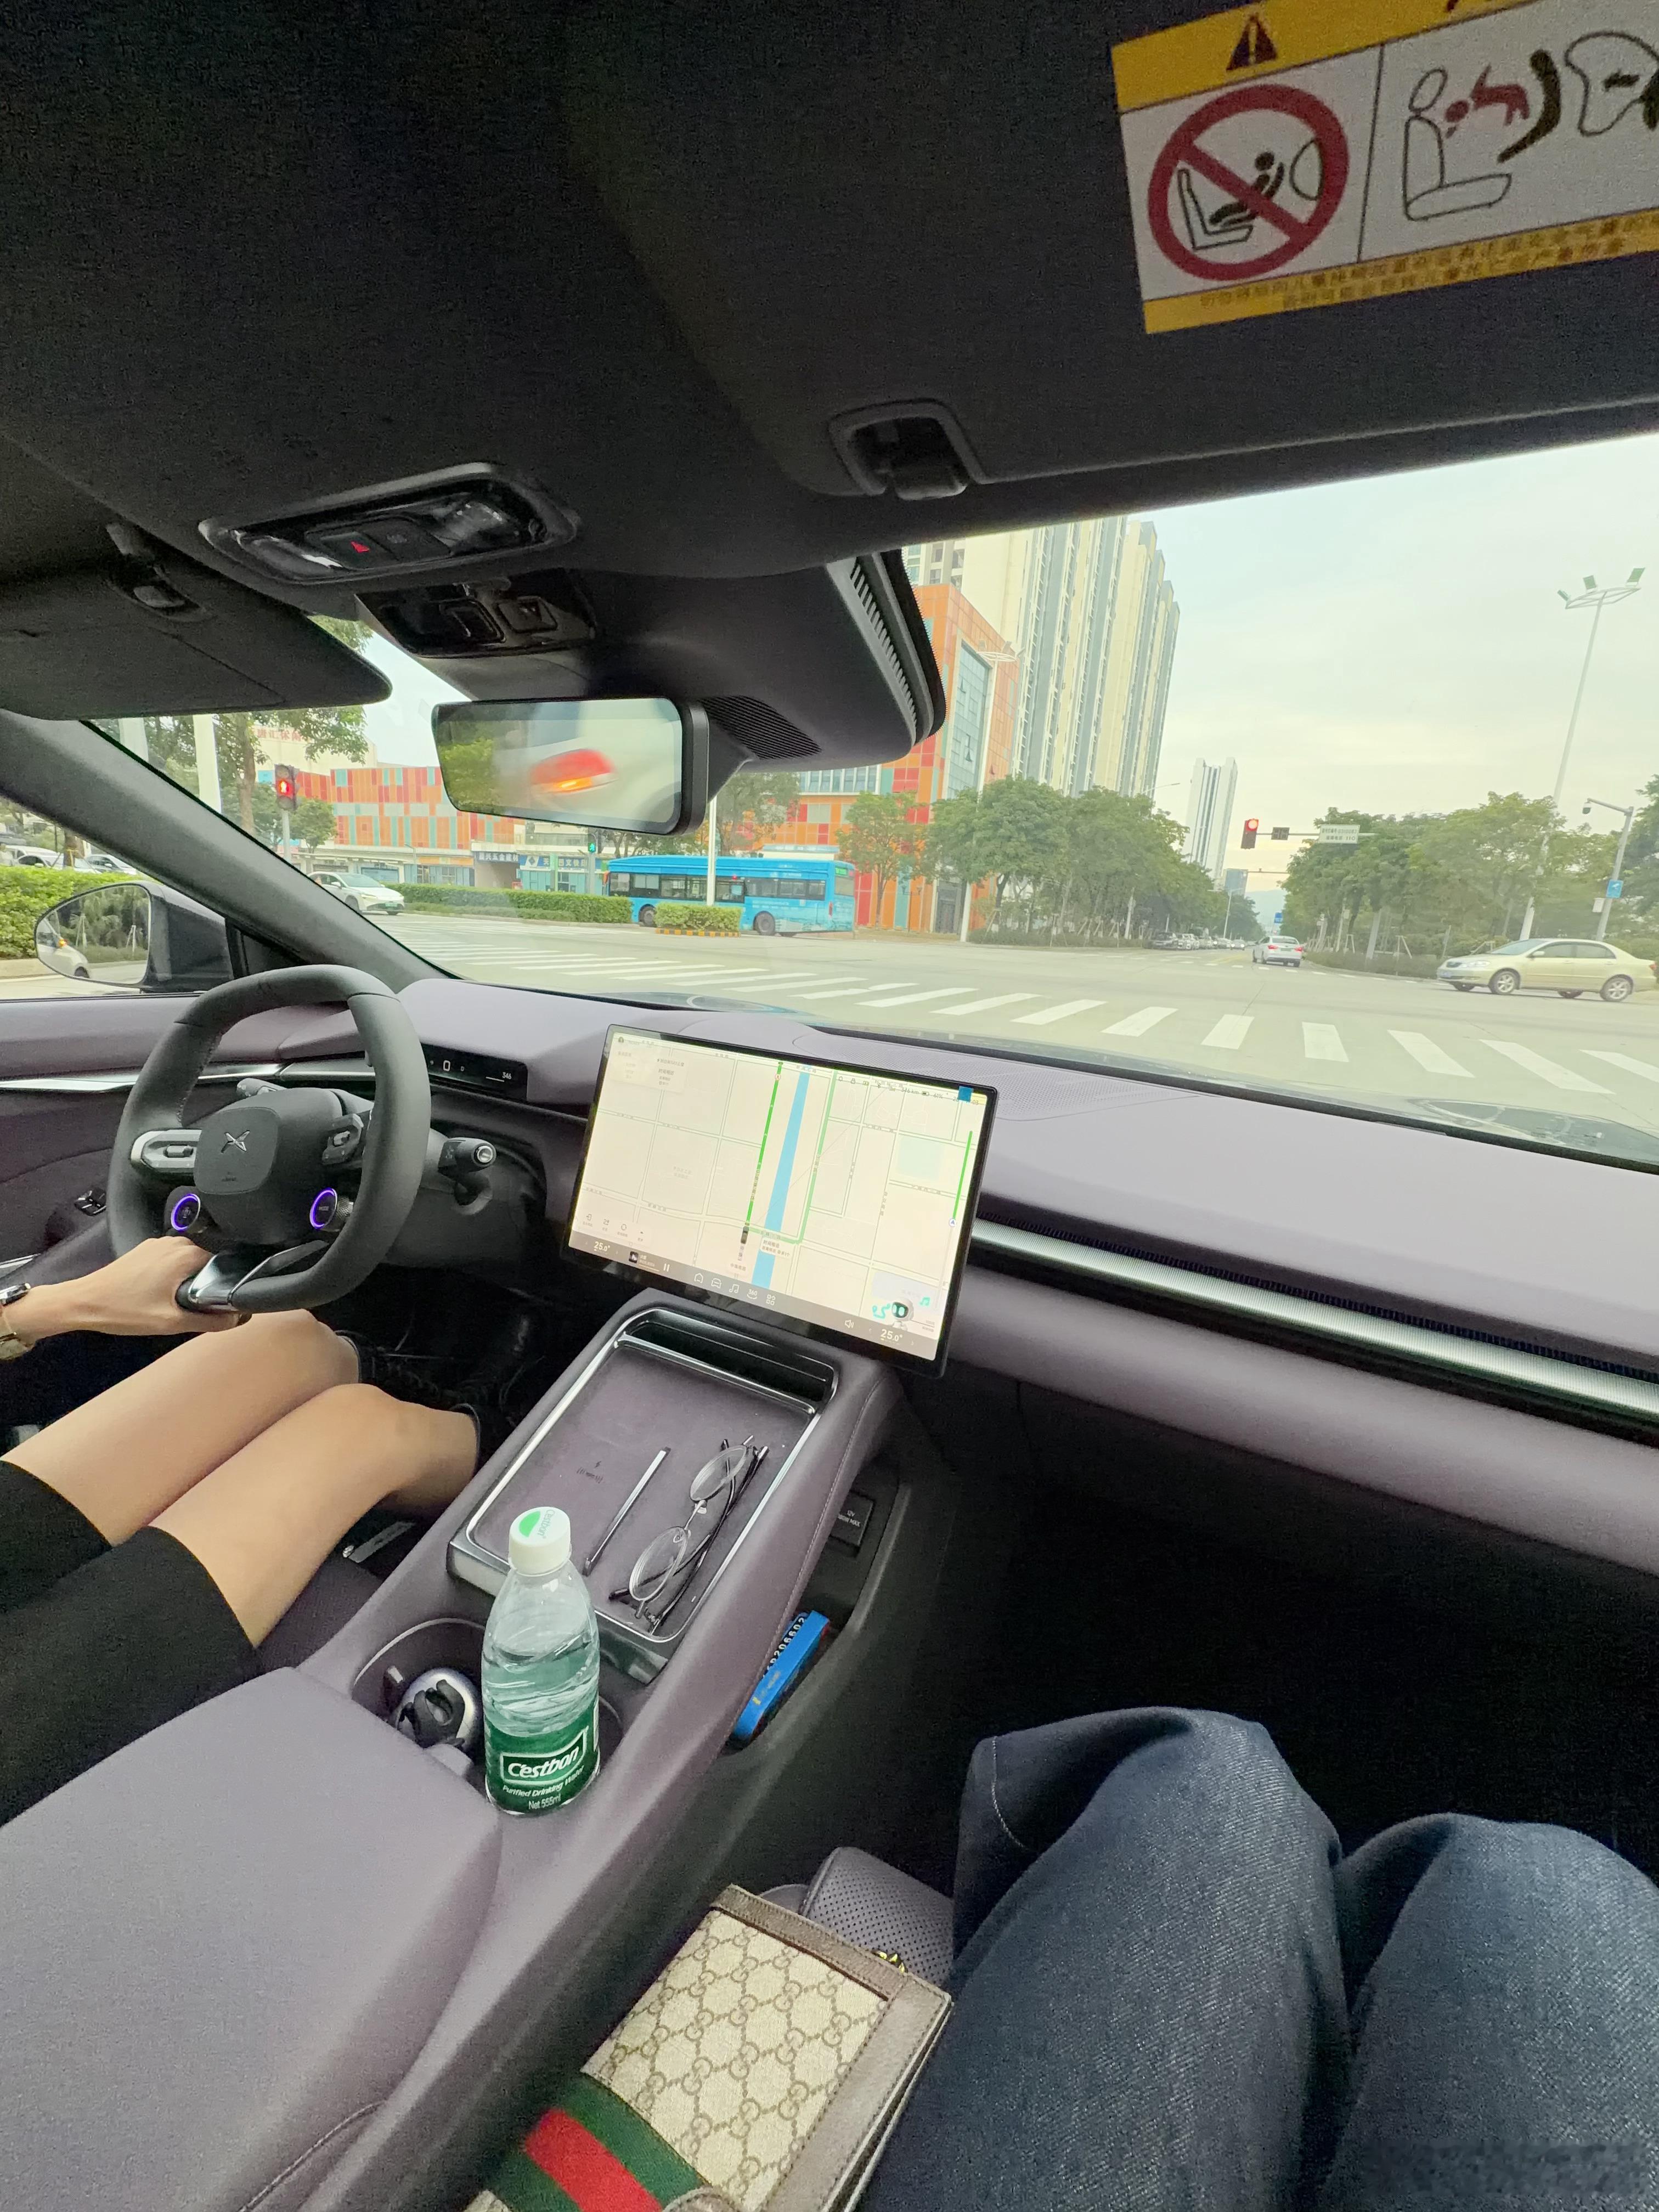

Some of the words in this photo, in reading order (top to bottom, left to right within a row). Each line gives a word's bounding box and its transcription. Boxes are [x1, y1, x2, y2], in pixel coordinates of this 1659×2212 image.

[443, 1060, 450, 1071] 0
[502, 1071, 512, 1080] 346
[881, 1329, 902, 1342] 25.0°
[503, 1785, 531, 1797] Purified
[532, 1782, 563, 1797] Drinking
[528, 1801, 540, 1810] Net
[540, 1793, 562, 1809] 555ml
